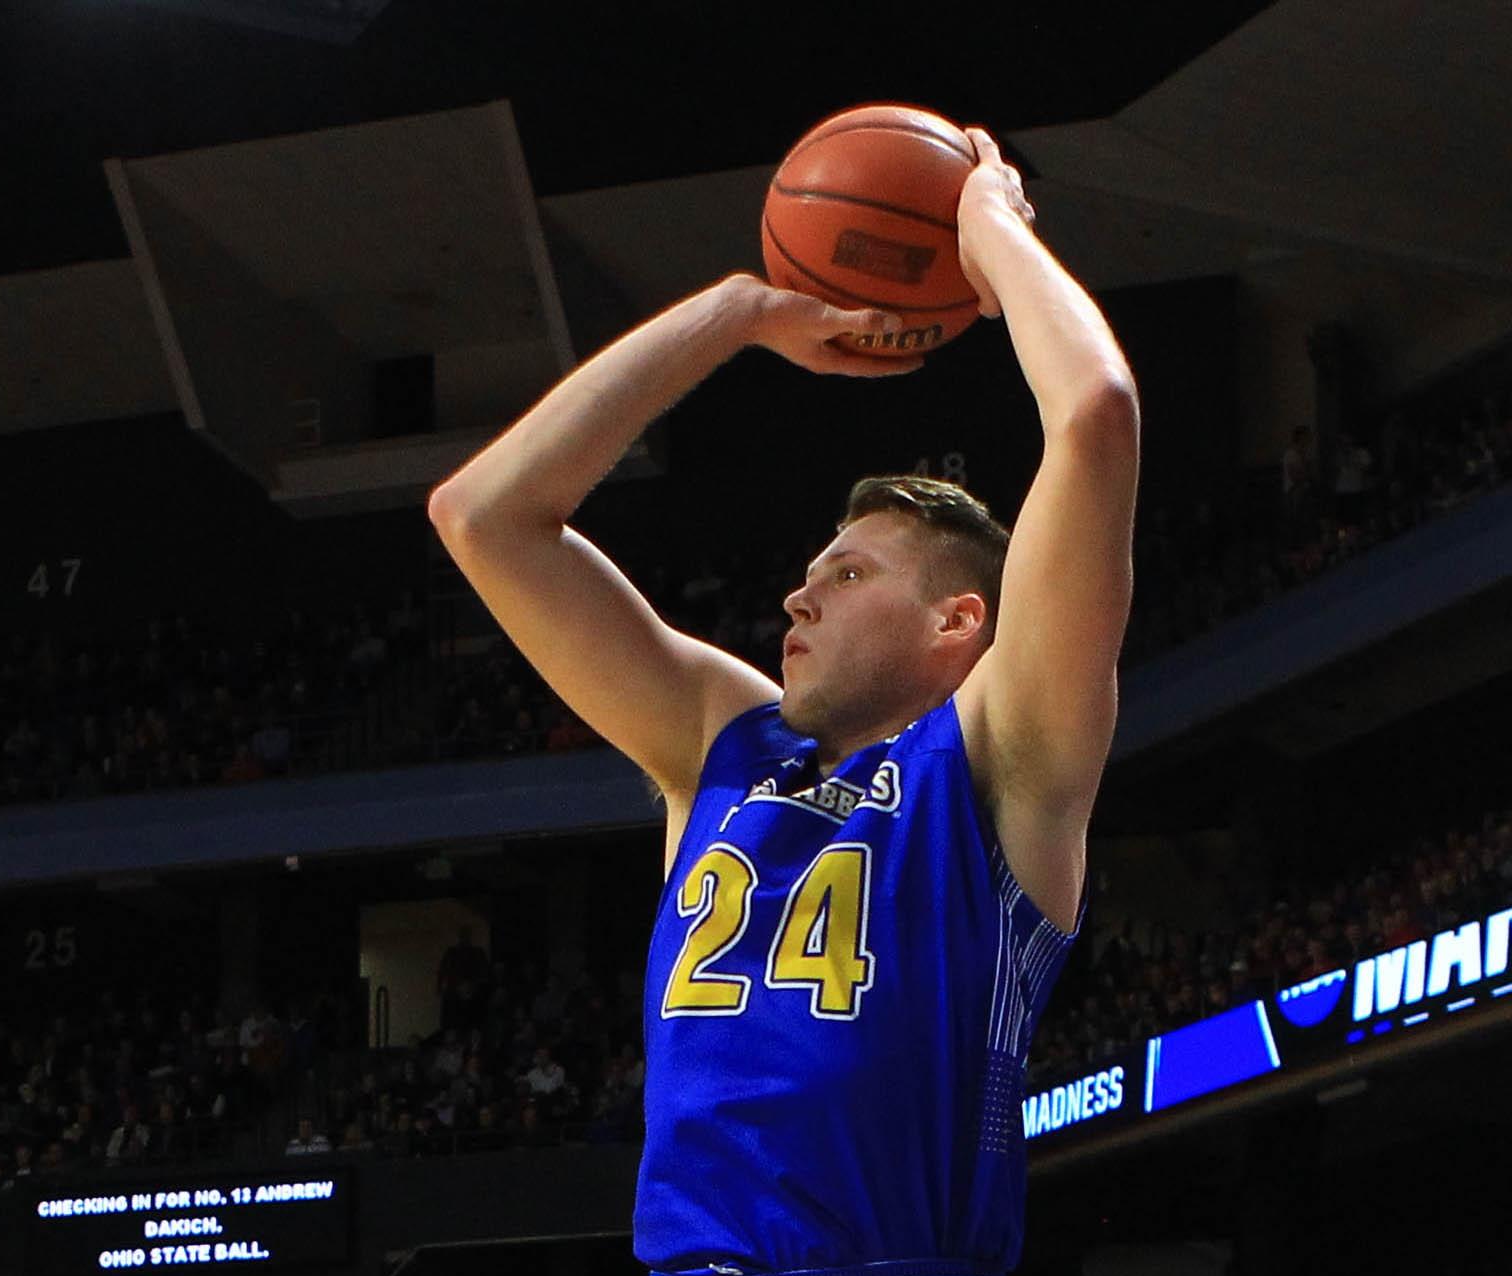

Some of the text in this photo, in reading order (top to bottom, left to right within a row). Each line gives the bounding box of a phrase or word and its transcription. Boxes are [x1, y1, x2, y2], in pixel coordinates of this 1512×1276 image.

[26, 552, 82, 599] 47
[23, 925, 78, 969] 25
[661, 841, 876, 1021] 24
[38, 1195, 127, 1217] CHECKING
[132, 1193, 151, 1211] IN
[155, 1191, 190, 1210] FOR
[194, 1189, 228, 1208] NO.
[255, 1180, 334, 1203] ANDREW
[144, 1216, 223, 1239] DAKICH.
[99, 1241, 270, 1269] OHIO STATE BALL.
